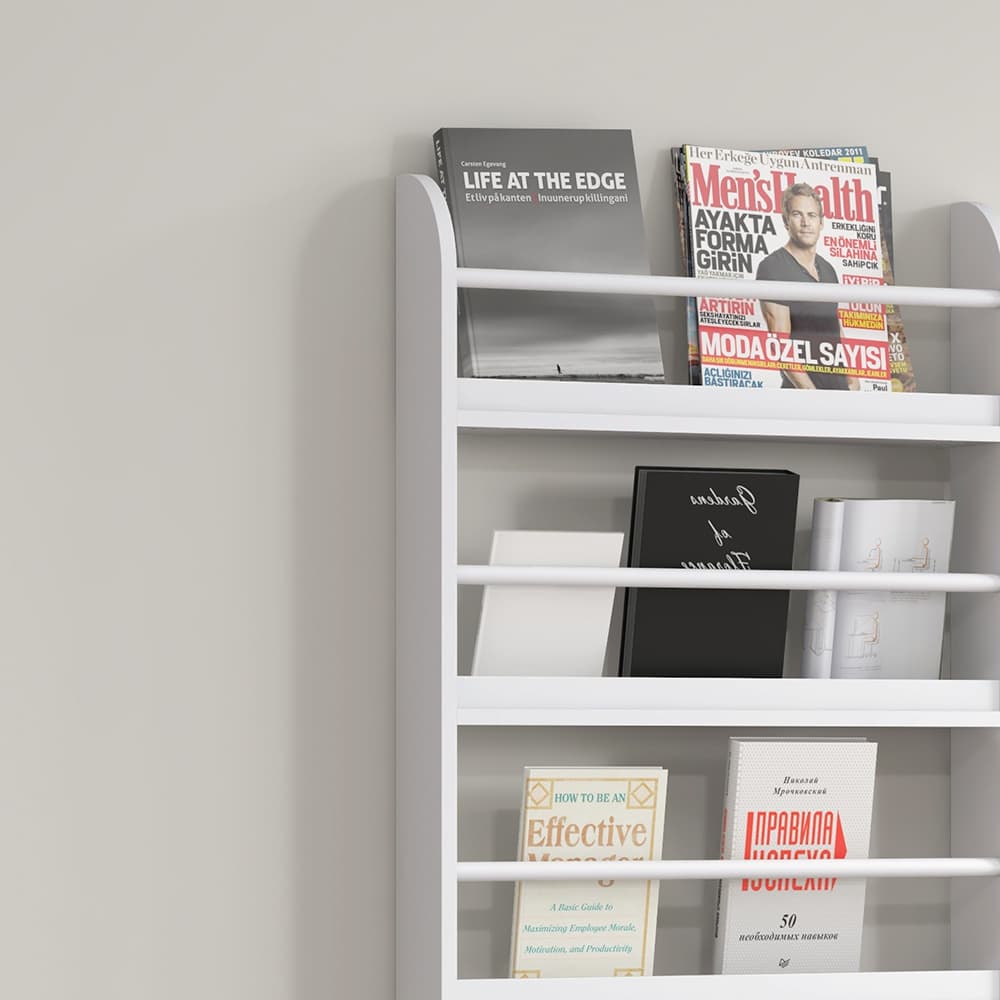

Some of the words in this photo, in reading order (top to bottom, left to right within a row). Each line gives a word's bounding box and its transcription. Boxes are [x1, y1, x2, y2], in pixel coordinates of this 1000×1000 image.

[803, 149, 842, 158] KOLEDAR
[845, 147, 863, 156] 2011
[689, 146, 713, 159] Her
[759, 153, 799, 169] Uygun
[801, 158, 872, 176] Antrenman
[463, 171, 504, 189] LIFE
[507, 171, 530, 189] AT
[533, 172, 572, 189] THE
[575, 172, 627, 190] EDGE
[770, 170, 875, 223] Halth
[695, 209, 777, 236] AYAKTA
[695, 229, 769, 255] FORMA
[856, 232, 877, 241] KORU
[700, 299, 755, 316] ARTIRIN
[701, 331, 766, 360] MODA
[765, 333, 818, 365] ÖZEL
[819, 342, 887, 371] SAYISI
[873, 384, 888, 392] Paul
[784, 776, 819, 785] Николай
[554, 793, 579, 804] HOW
[580, 793, 595, 803] TO
[596, 793, 611, 803] BE
[611, 792, 627, 803] AN
[527, 815, 647, 848] Effective
[754, 811, 834, 846] ПРАВИЛА
[550, 903, 557, 912] A
[558, 903, 580, 912] Basic
[580, 902, 603, 912] Guide
[604, 902, 614, 911] to
[523, 924, 568, 935] Maximizing
[569, 923, 607, 934] Employee
[779, 913, 797, 929] 50
[738, 931, 800, 942] необходимых
[801, 932, 839, 941] навыков
[568, 944, 585, 954] and
[585, 944, 633, 954] Productivity
